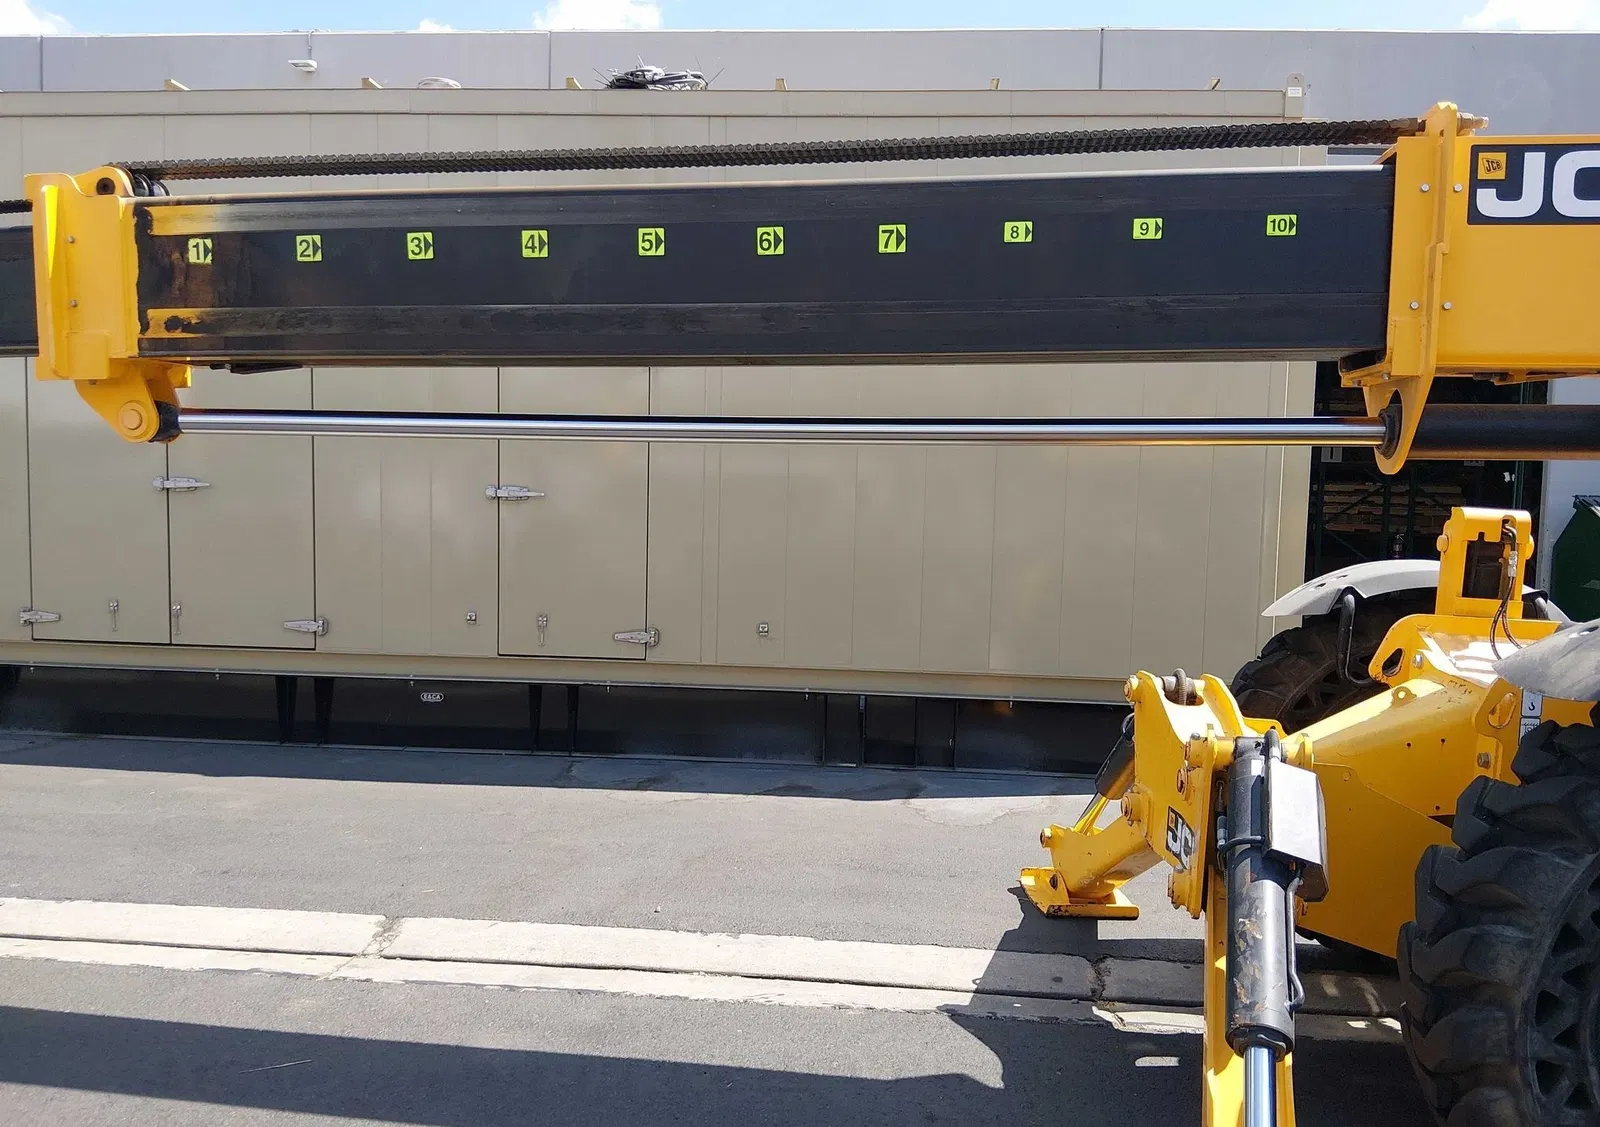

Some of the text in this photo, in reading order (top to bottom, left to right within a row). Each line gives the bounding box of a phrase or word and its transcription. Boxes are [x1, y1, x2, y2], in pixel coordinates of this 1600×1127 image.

[1485, 159, 1501, 173] JCB
[1010, 225, 1020, 239] 8
[1139, 222, 1149, 235] 9
[1269, 218, 1288, 231] 10
[299, 239, 311, 258] 2
[410, 236, 423, 256] 3
[524, 234, 537, 254] 4
[641, 232, 653, 252] 5
[758, 231, 772, 251] 6
[881, 229, 895, 249] 7
[192, 241, 201, 260] 1
